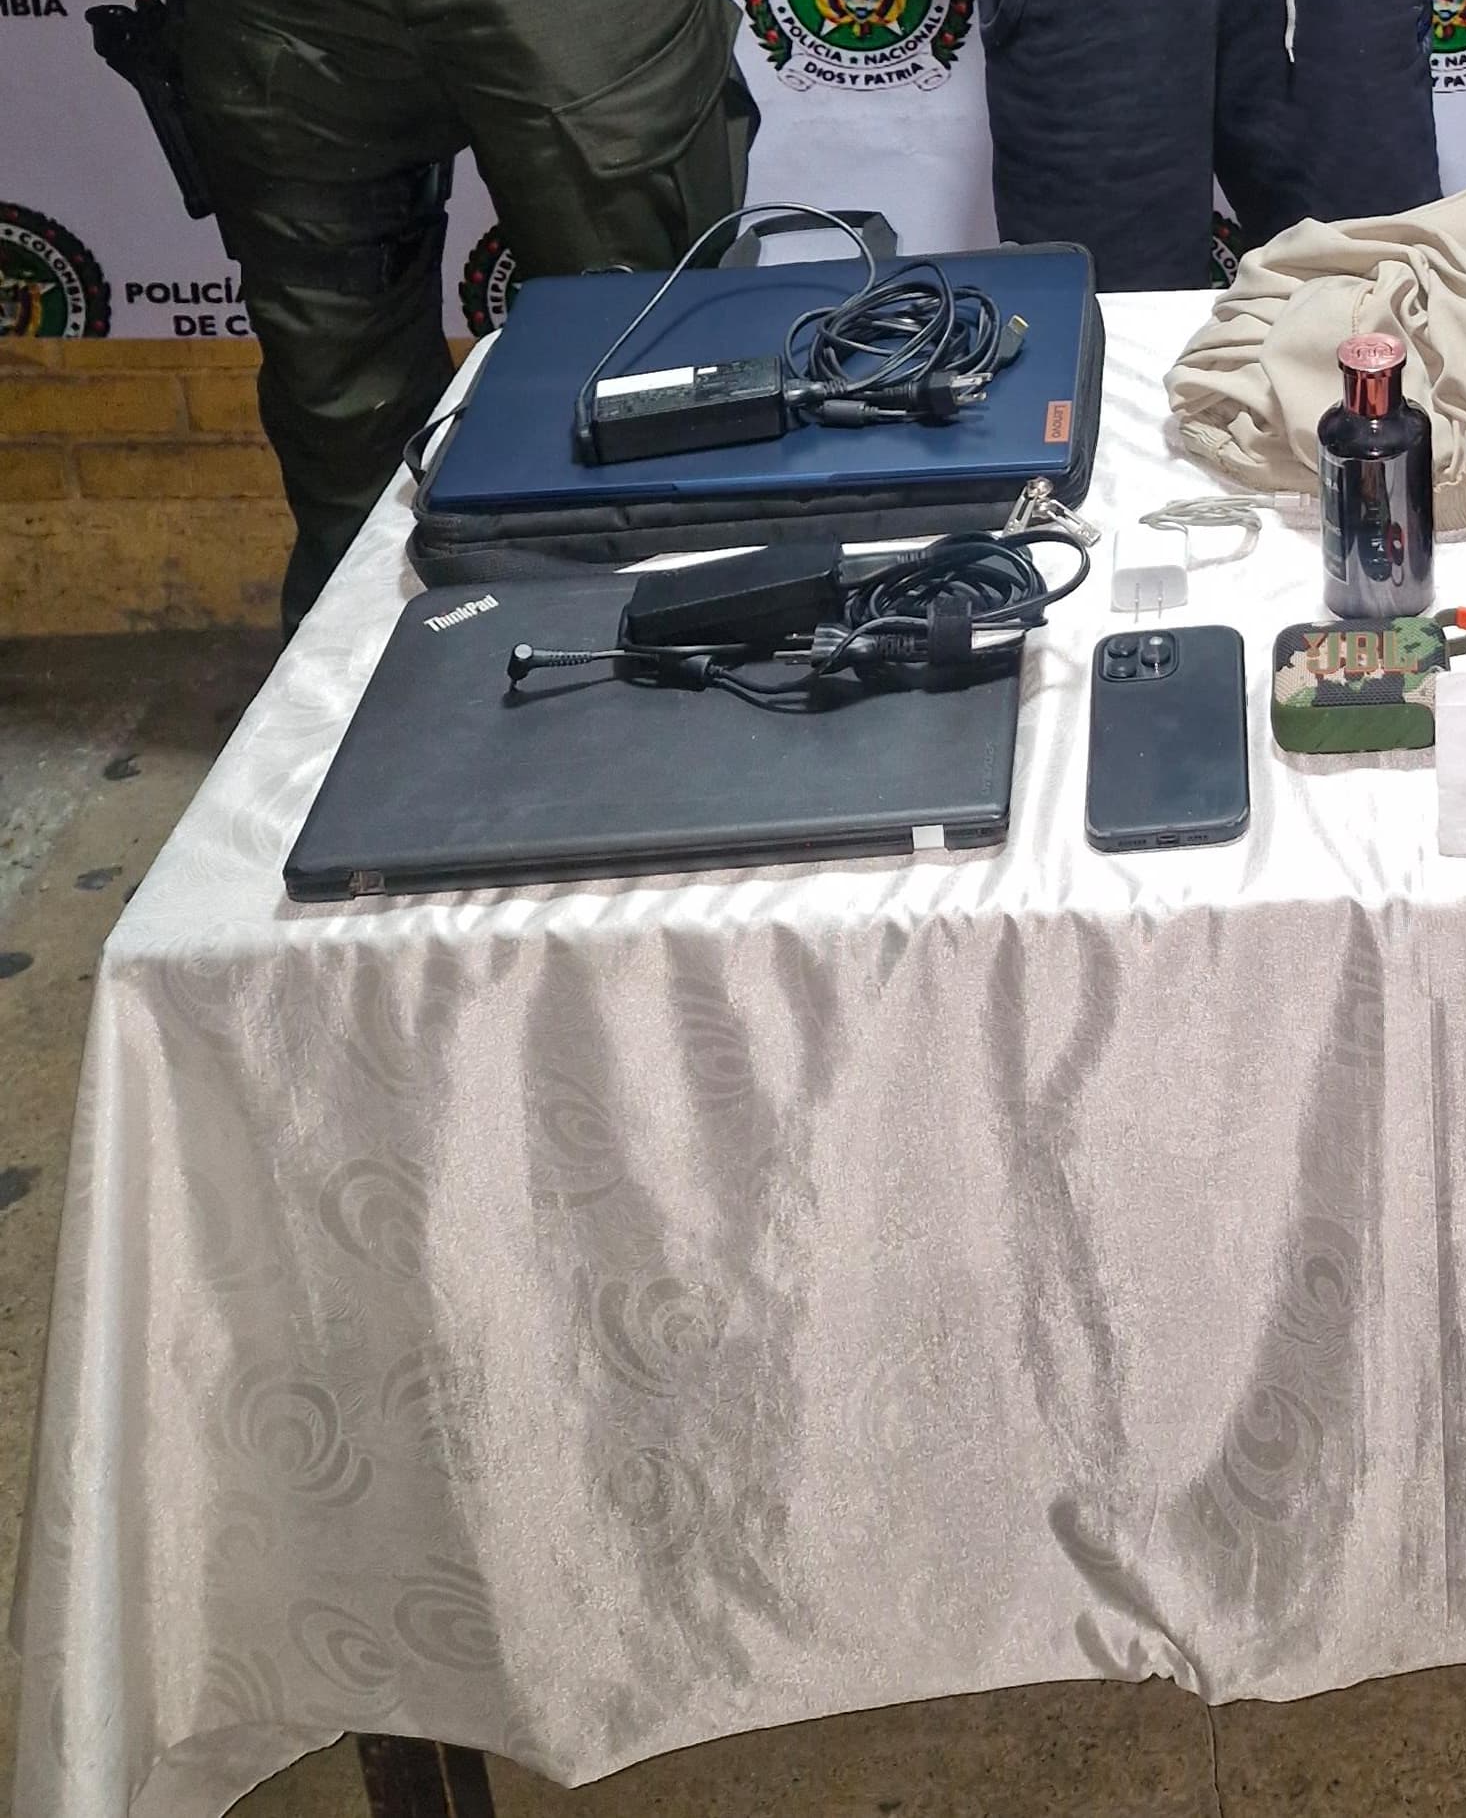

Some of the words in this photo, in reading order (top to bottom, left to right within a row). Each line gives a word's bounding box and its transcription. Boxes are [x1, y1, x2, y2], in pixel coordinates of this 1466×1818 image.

[781, 16, 842, 63] POLICIA
[864, 17, 941, 66] NACIONAL
[804, 61, 847, 84] DIOS
[848, 74, 859, 86] Y
[864, 62, 925, 85] PATRIA
[19, 233, 83, 314] COLOMBIA
[173, 315, 217, 336] DE
[1052, 405, 1066, 439] Lenovo
[424, 594, 499, 632] ThinkPad
[1303, 631, 1418, 675] JBL
